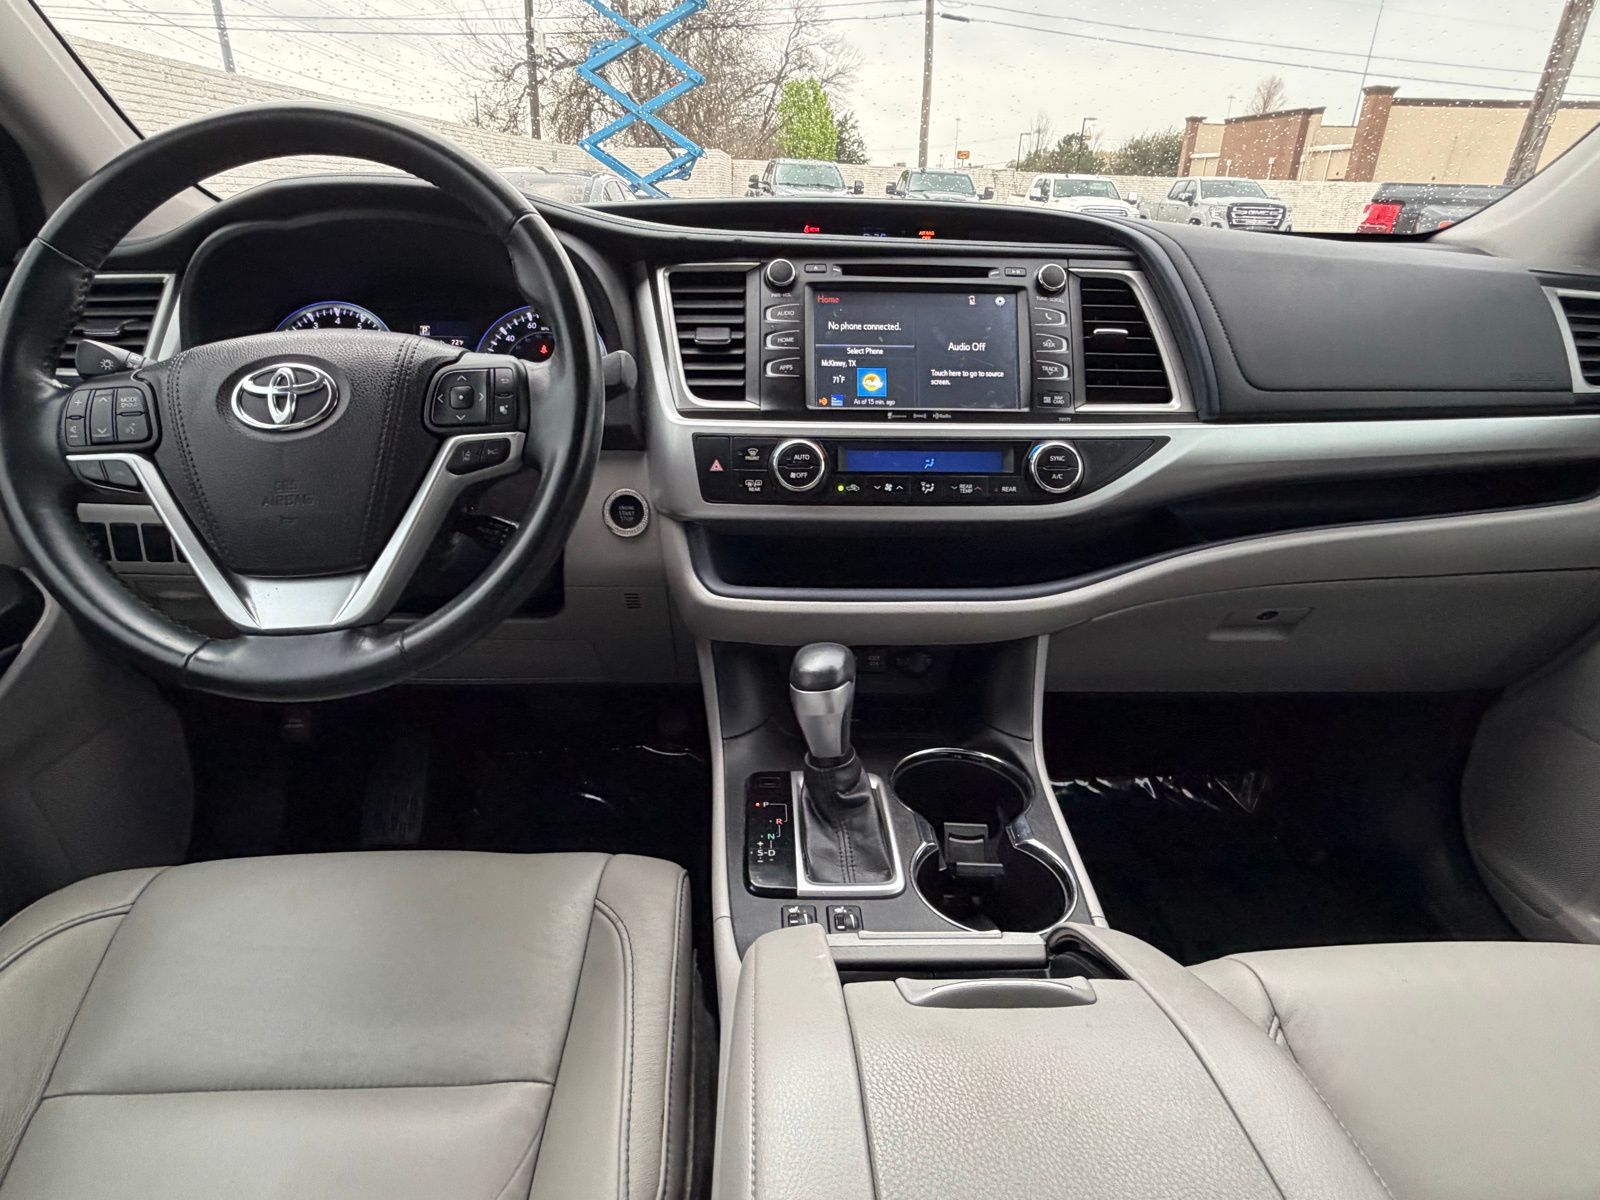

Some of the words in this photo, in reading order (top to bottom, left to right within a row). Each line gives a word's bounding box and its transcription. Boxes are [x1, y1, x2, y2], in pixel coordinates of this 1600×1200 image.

[816, 295, 840, 304] Home
[777, 309, 795, 317] AUDIO
[334, 317, 341, 325] 4
[312, 322, 319, 330] 3
[527, 322, 537, 330] 60
[828, 321, 840, 330] No
[840, 321, 862, 332] phone
[863, 322, 902, 331] connected.
[777, 336, 795, 344] HOME
[846, 347, 865, 355] Select
[865, 347, 884, 355] Phone
[947, 342, 971, 352] Audio
[971, 342, 987, 352] Off
[848, 359, 857, 367] TX
[930, 369, 949, 377] Touch
[948, 369, 962, 377] here
[969, 371, 978, 379] go
[885, 399, 896, 407] ago
[793, 453, 810, 461] AUTO
[796, 471, 808, 479] OFF
